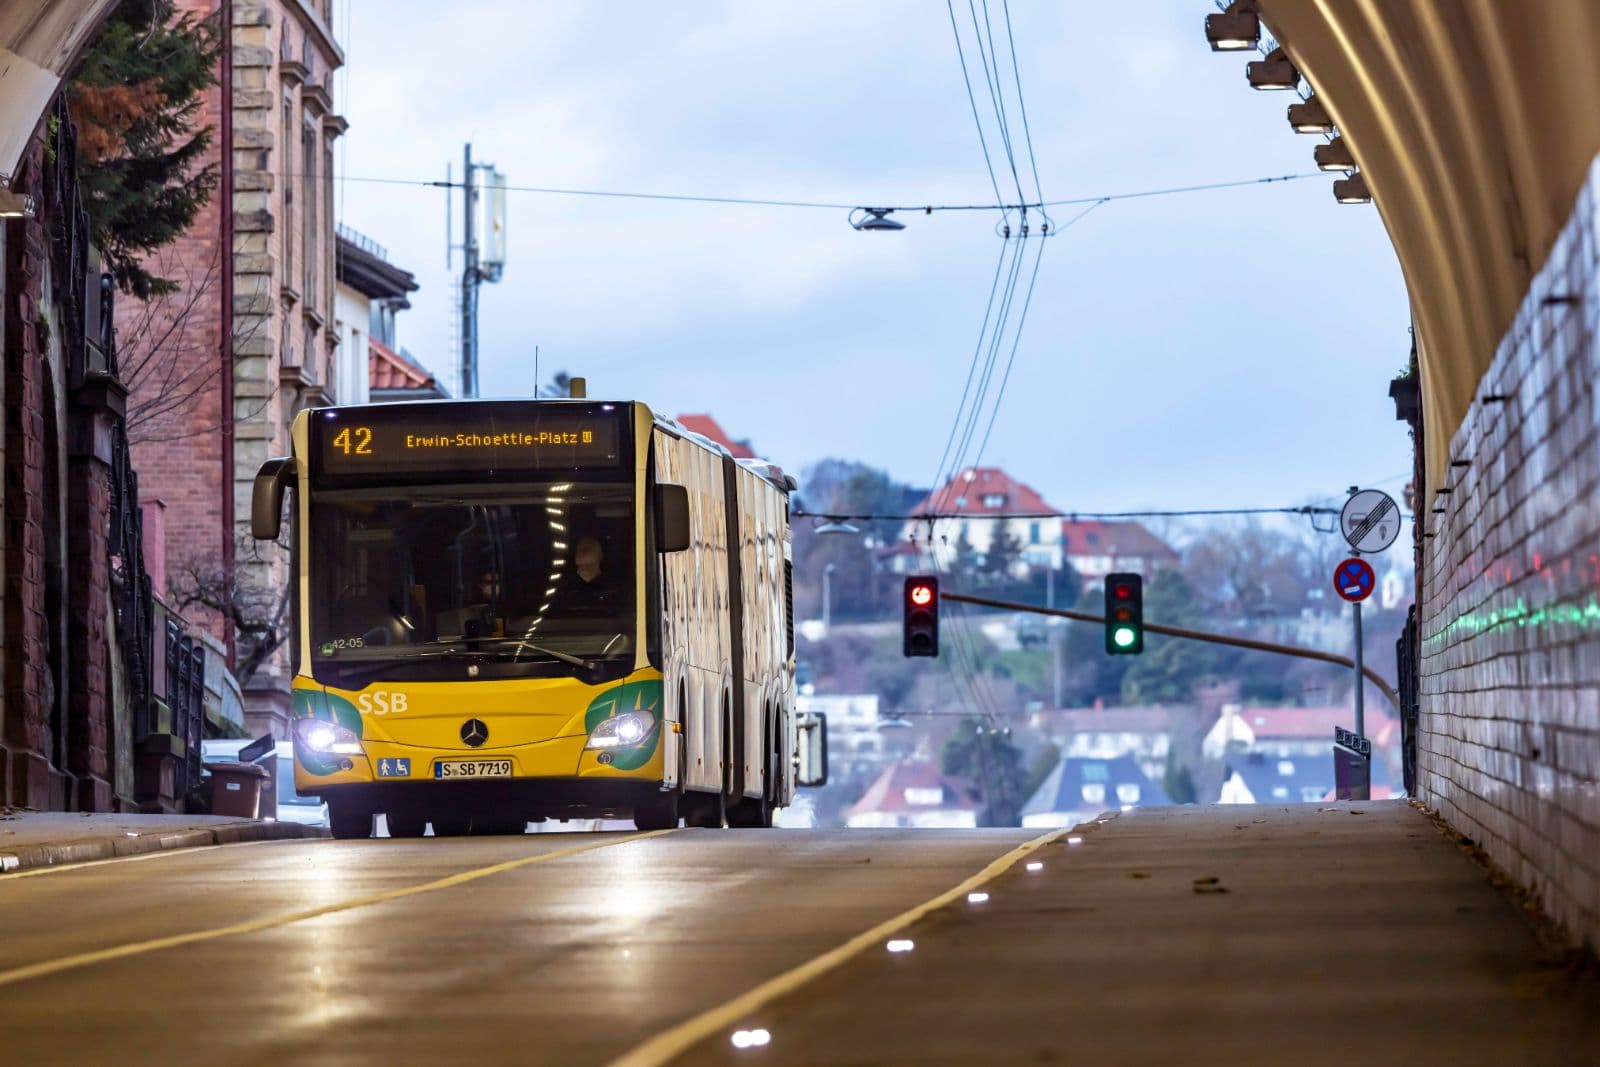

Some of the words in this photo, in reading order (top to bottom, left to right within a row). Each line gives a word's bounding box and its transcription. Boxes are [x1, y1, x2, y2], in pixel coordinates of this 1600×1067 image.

[333, 427, 372, 455] 42
[407, 431, 578, 448] Erwin-Schoettle-Platz
[358, 691, 408, 716] SSB
[443, 764, 451, 777] S
[460, 763, 476, 776] SB
[478, 762, 509, 776] 7719
